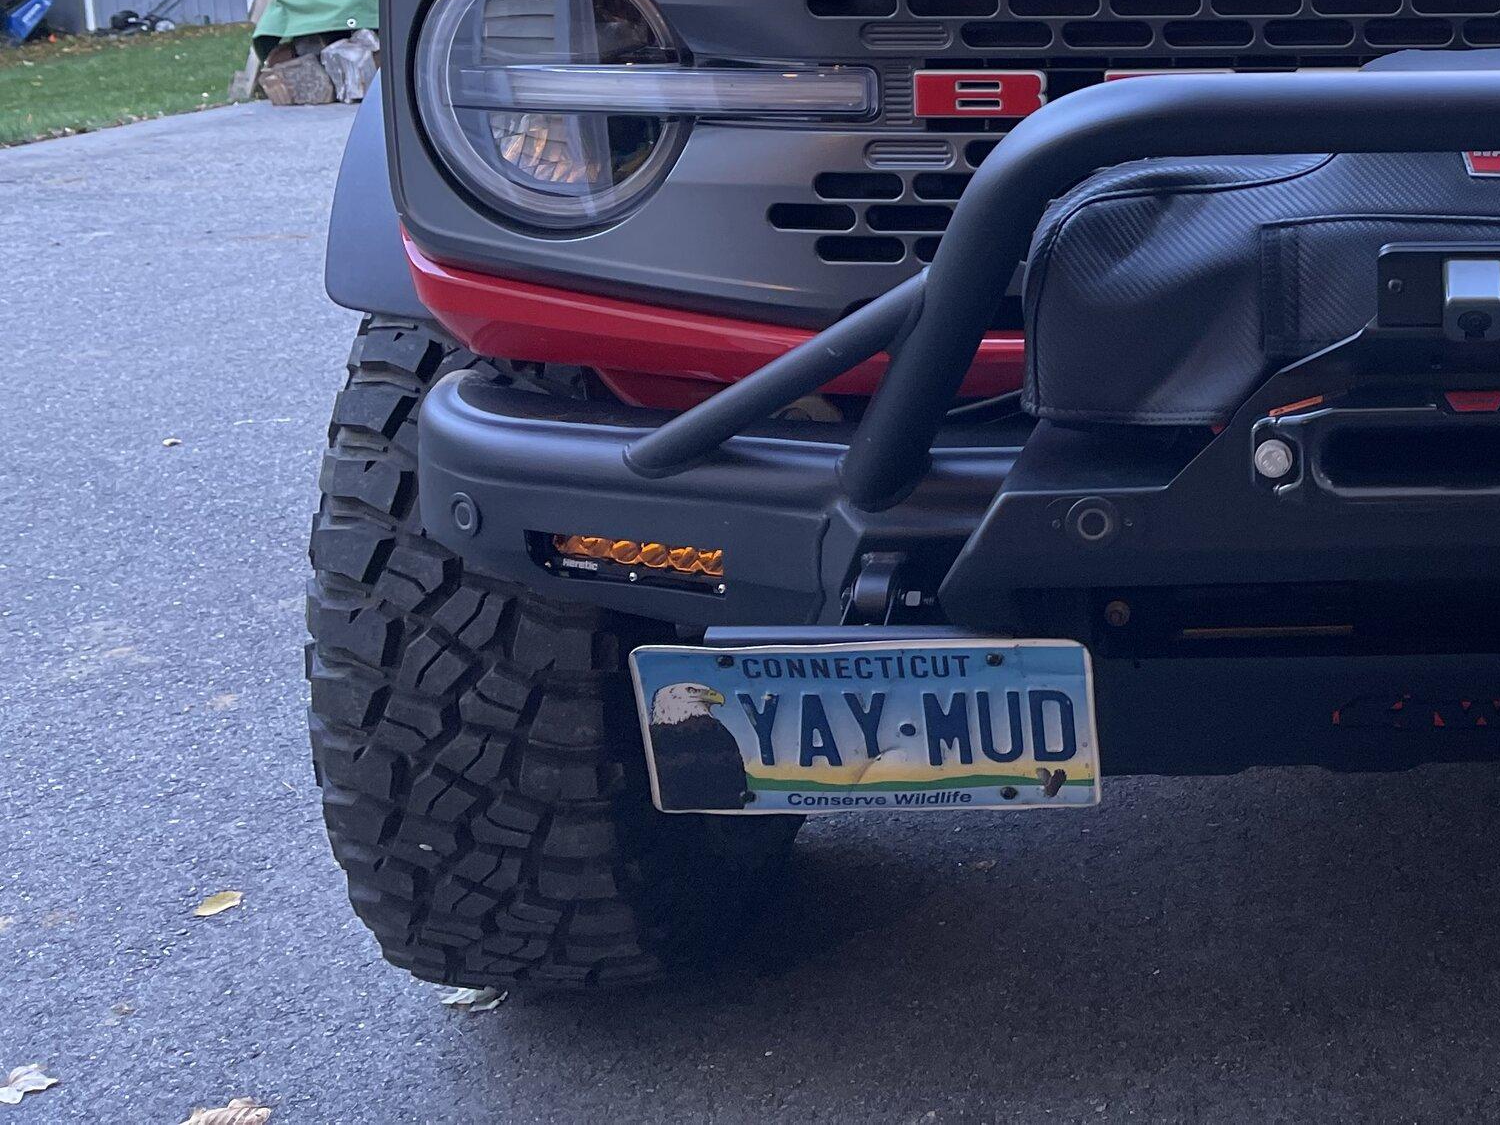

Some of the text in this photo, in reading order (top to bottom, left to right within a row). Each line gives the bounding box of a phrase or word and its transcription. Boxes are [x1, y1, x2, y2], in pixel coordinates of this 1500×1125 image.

[741, 654, 971, 680] CONNECTICUT
[787, 789, 972, 807] Conserve Wildlife
